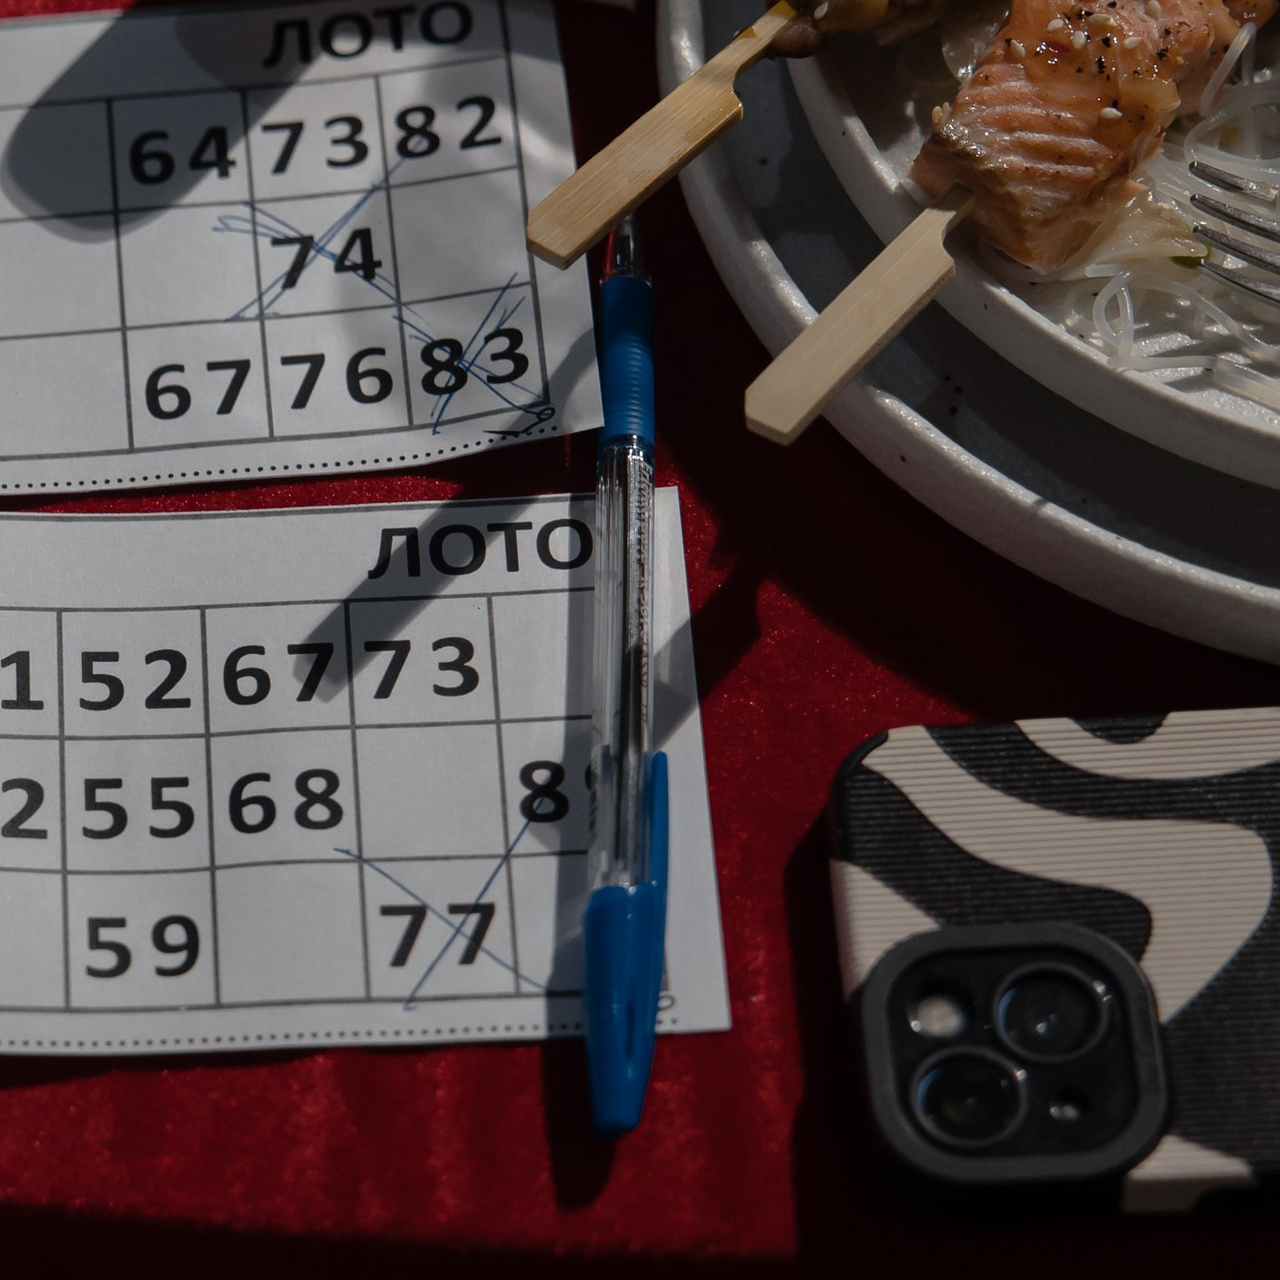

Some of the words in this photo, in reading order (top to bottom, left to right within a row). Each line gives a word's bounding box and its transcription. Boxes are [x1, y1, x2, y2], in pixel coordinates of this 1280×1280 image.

[263, 0, 473, 68] ЛОТО
[129, 126, 236, 184] 64
[263, 116, 368, 174] 73
[396, 96, 502, 157] 82
[271, 228, 382, 290] 74
[145, 359, 251, 420] 67
[280, 348, 392, 409] 76
[420, 329, 528, 395] 83
[368, 518, 594, 579] ЛОТО
[79, 649, 191, 711] 52
[223, 643, 334, 705] 67
[365, 636, 479, 699] 73
[82, 776, 194, 839] 55
[228, 769, 343, 833] 68
[519, 760, 596, 823] 8
[86, 915, 200, 978] 59
[380, 902, 495, 968] 77
